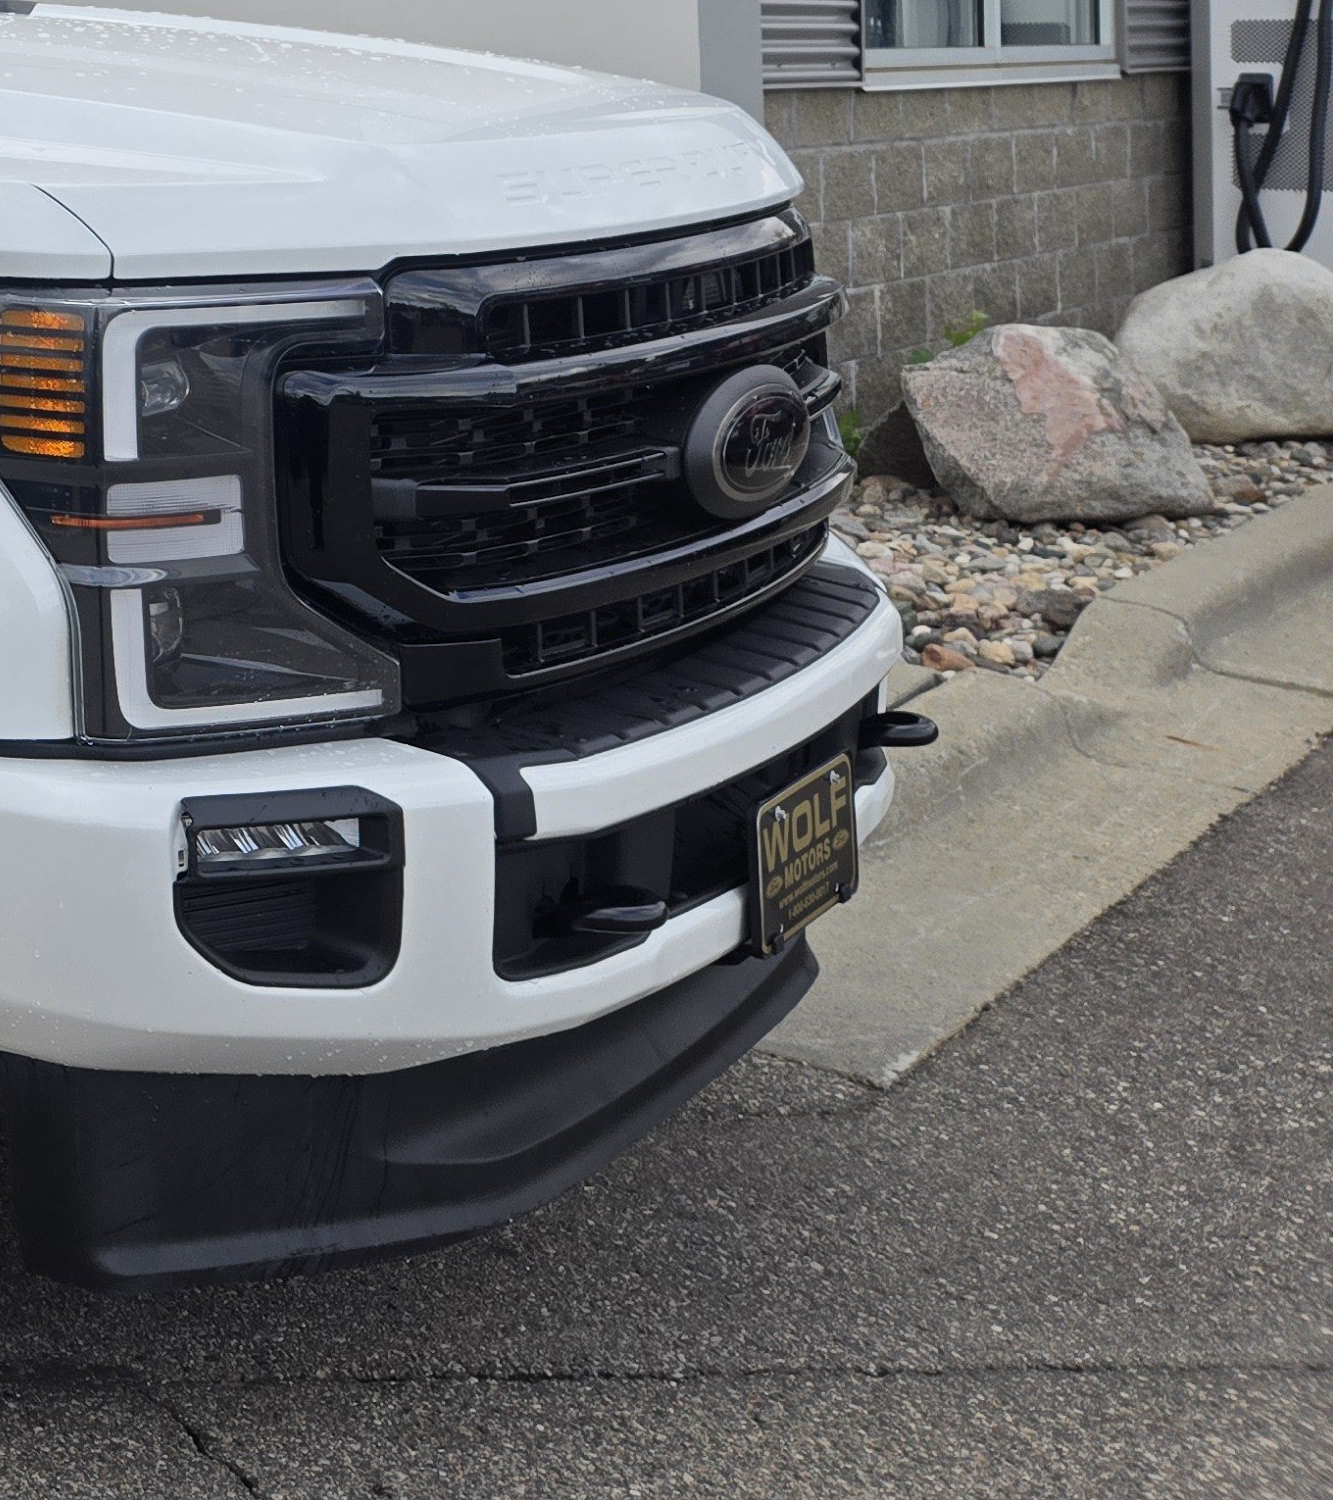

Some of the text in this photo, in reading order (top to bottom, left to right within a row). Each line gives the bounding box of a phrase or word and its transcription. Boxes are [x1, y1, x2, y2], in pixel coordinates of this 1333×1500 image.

[744, 410, 796, 478] Ford
[763, 775, 848, 874] WOLF
[783, 837, 831, 890] MOTORS
